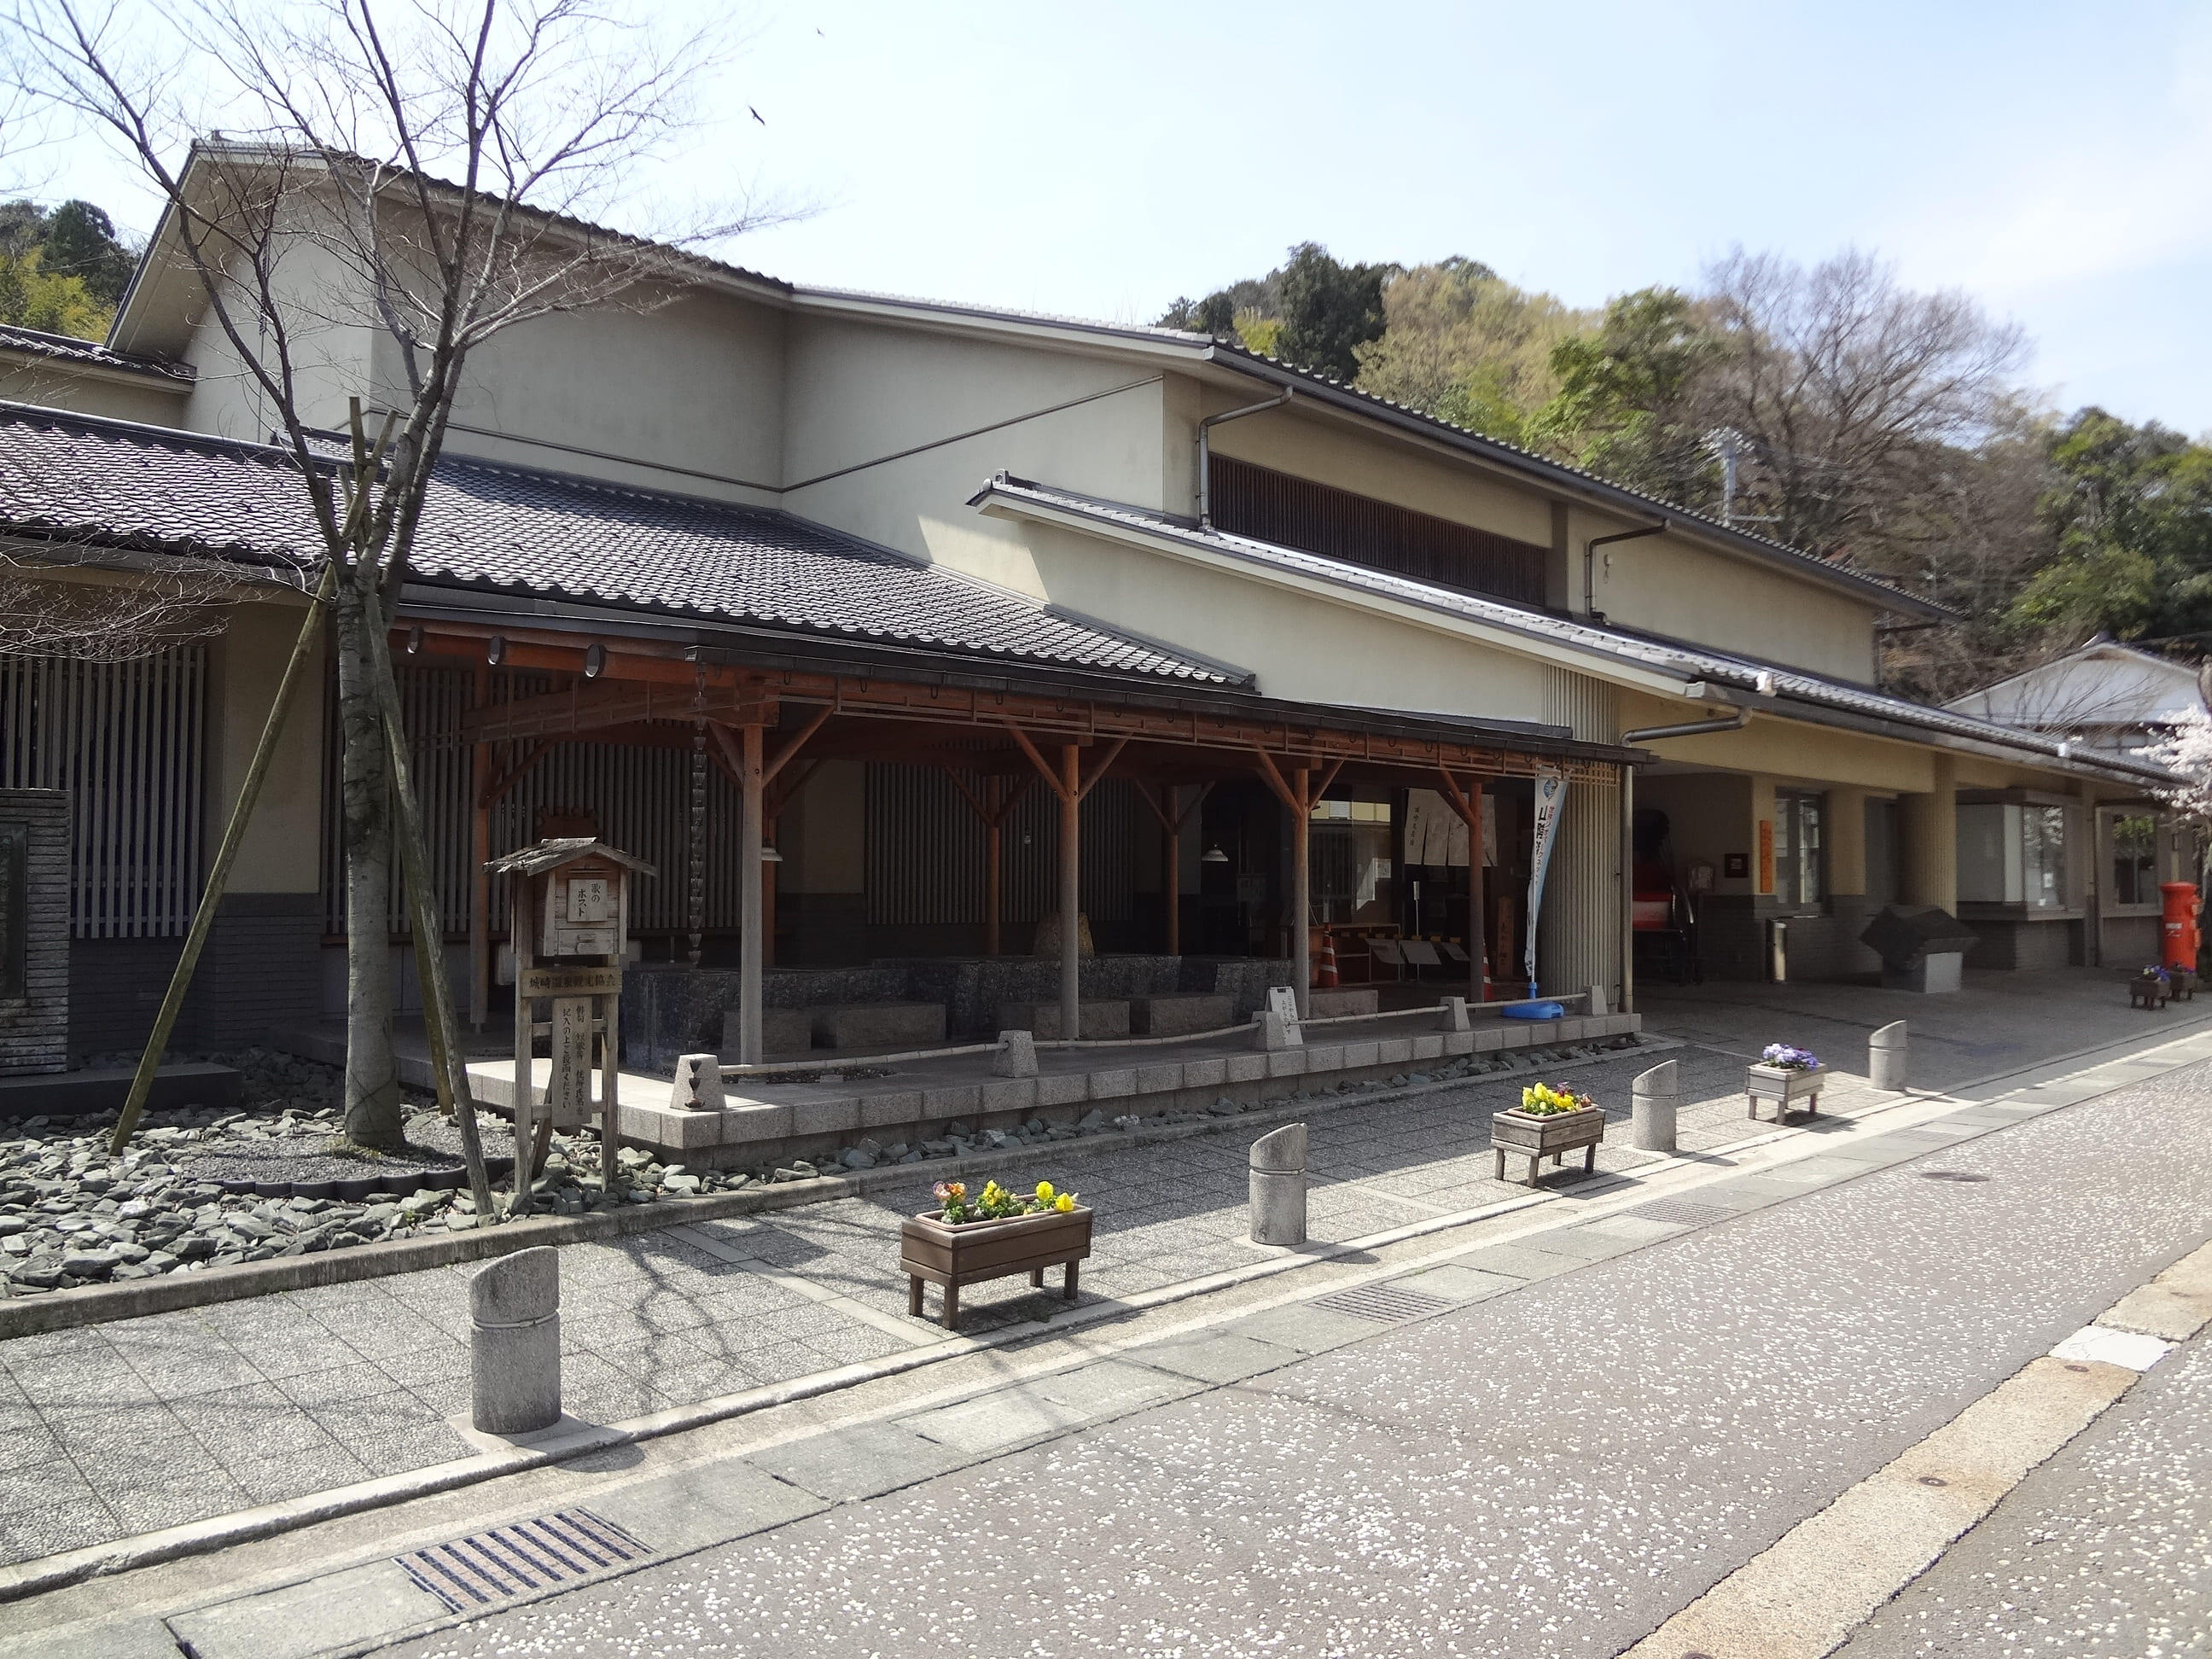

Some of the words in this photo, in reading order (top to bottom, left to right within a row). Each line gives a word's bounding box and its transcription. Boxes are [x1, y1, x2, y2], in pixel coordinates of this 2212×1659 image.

[591, 882, 601, 903] 歌の
[529, 975, 615, 989] 城崎温泉観光協会
